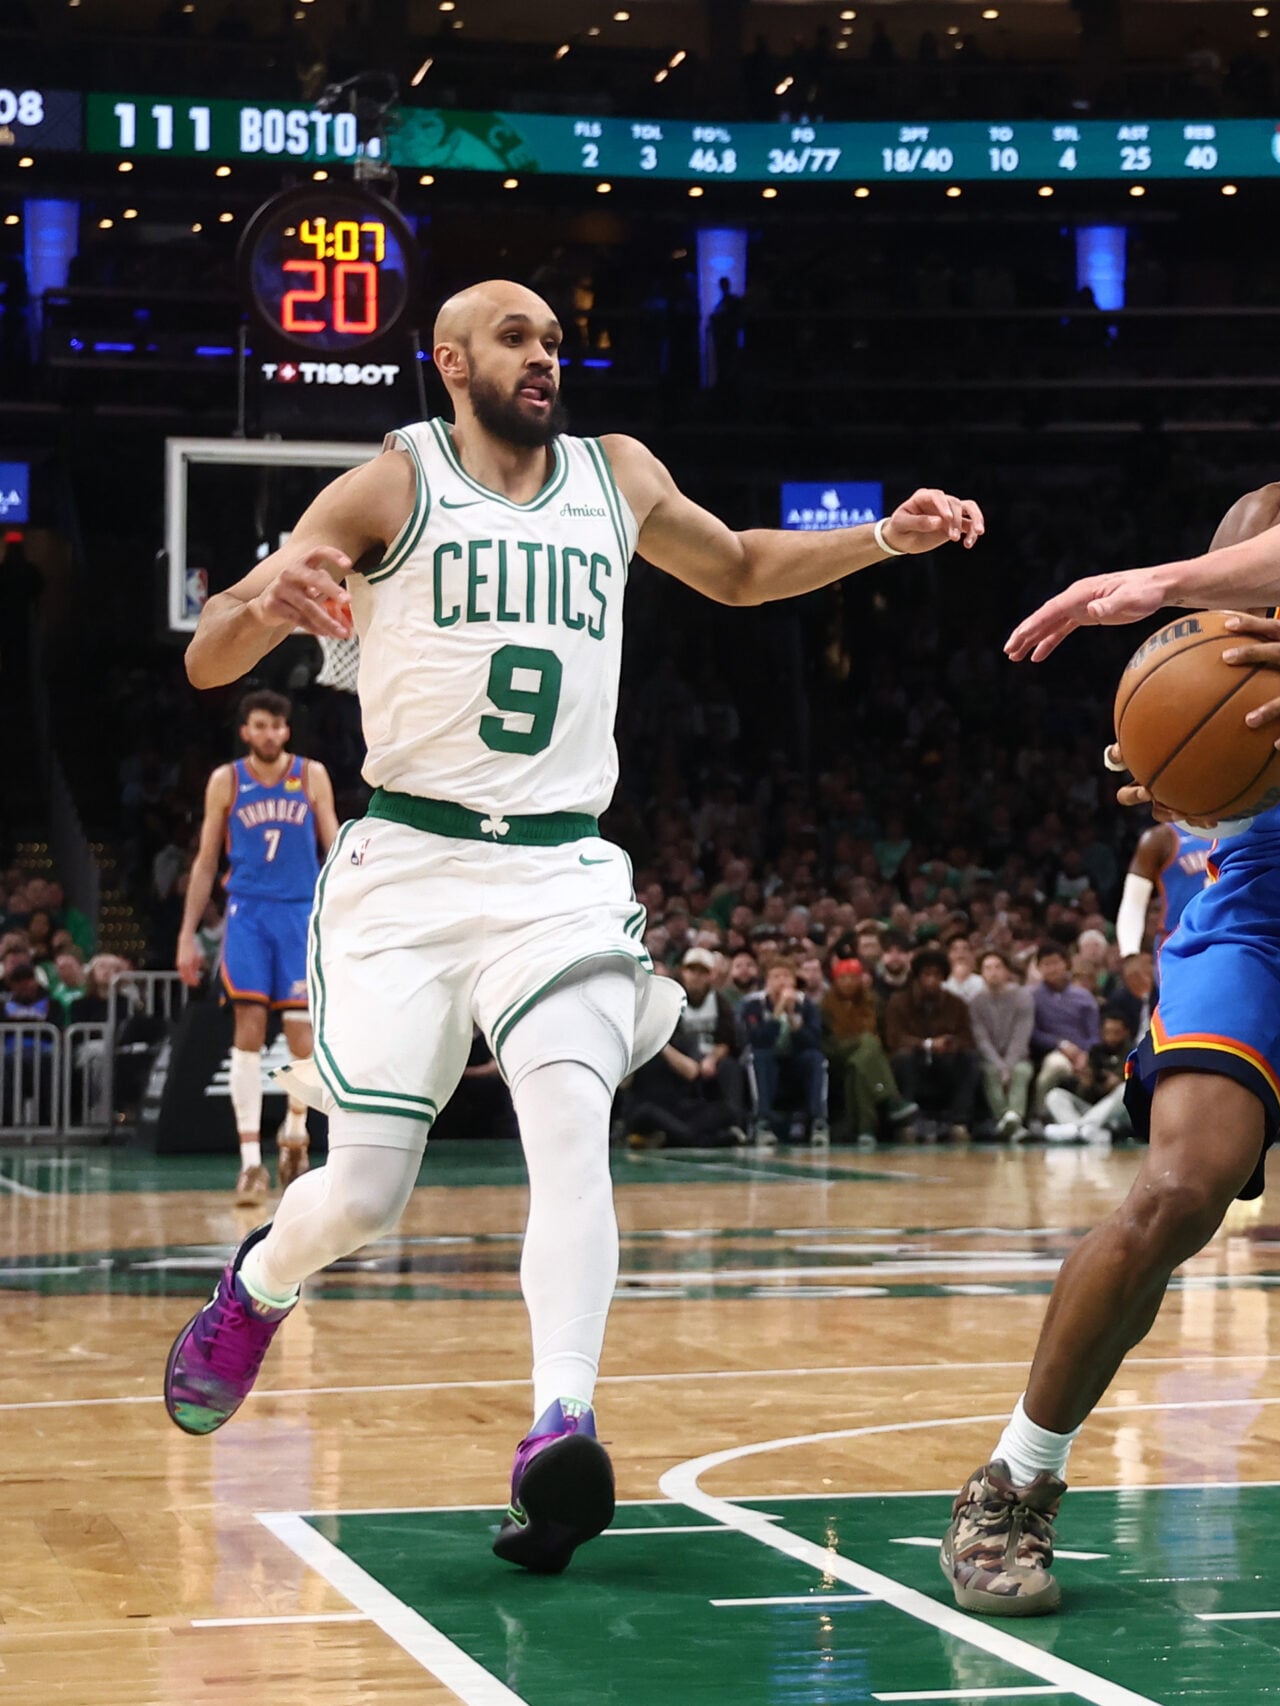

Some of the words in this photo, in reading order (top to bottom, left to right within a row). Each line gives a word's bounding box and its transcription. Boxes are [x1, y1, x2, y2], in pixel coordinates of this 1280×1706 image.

[581, 143, 599, 168] 2
[639, 145, 657, 170] 3
[688, 148, 737, 173] 46.8
[767, 147, 841, 173] 36/77
[882, 146, 954, 172] 18/40
[989, 147, 1019, 172] 10
[1057, 147, 1077, 171] 4
[1120, 147, 1151, 171] 25
[1184, 146, 1218, 170] 40
[300, 219, 385, 262] 4:07
[281, 260, 378, 334] 20
[298, 362, 400, 386] TISSOT
[560, 503, 606, 517] Amica
[433, 539, 612, 641] CELTICS
[478, 644, 562, 755] 9
[263, 828, 282, 862] 7
